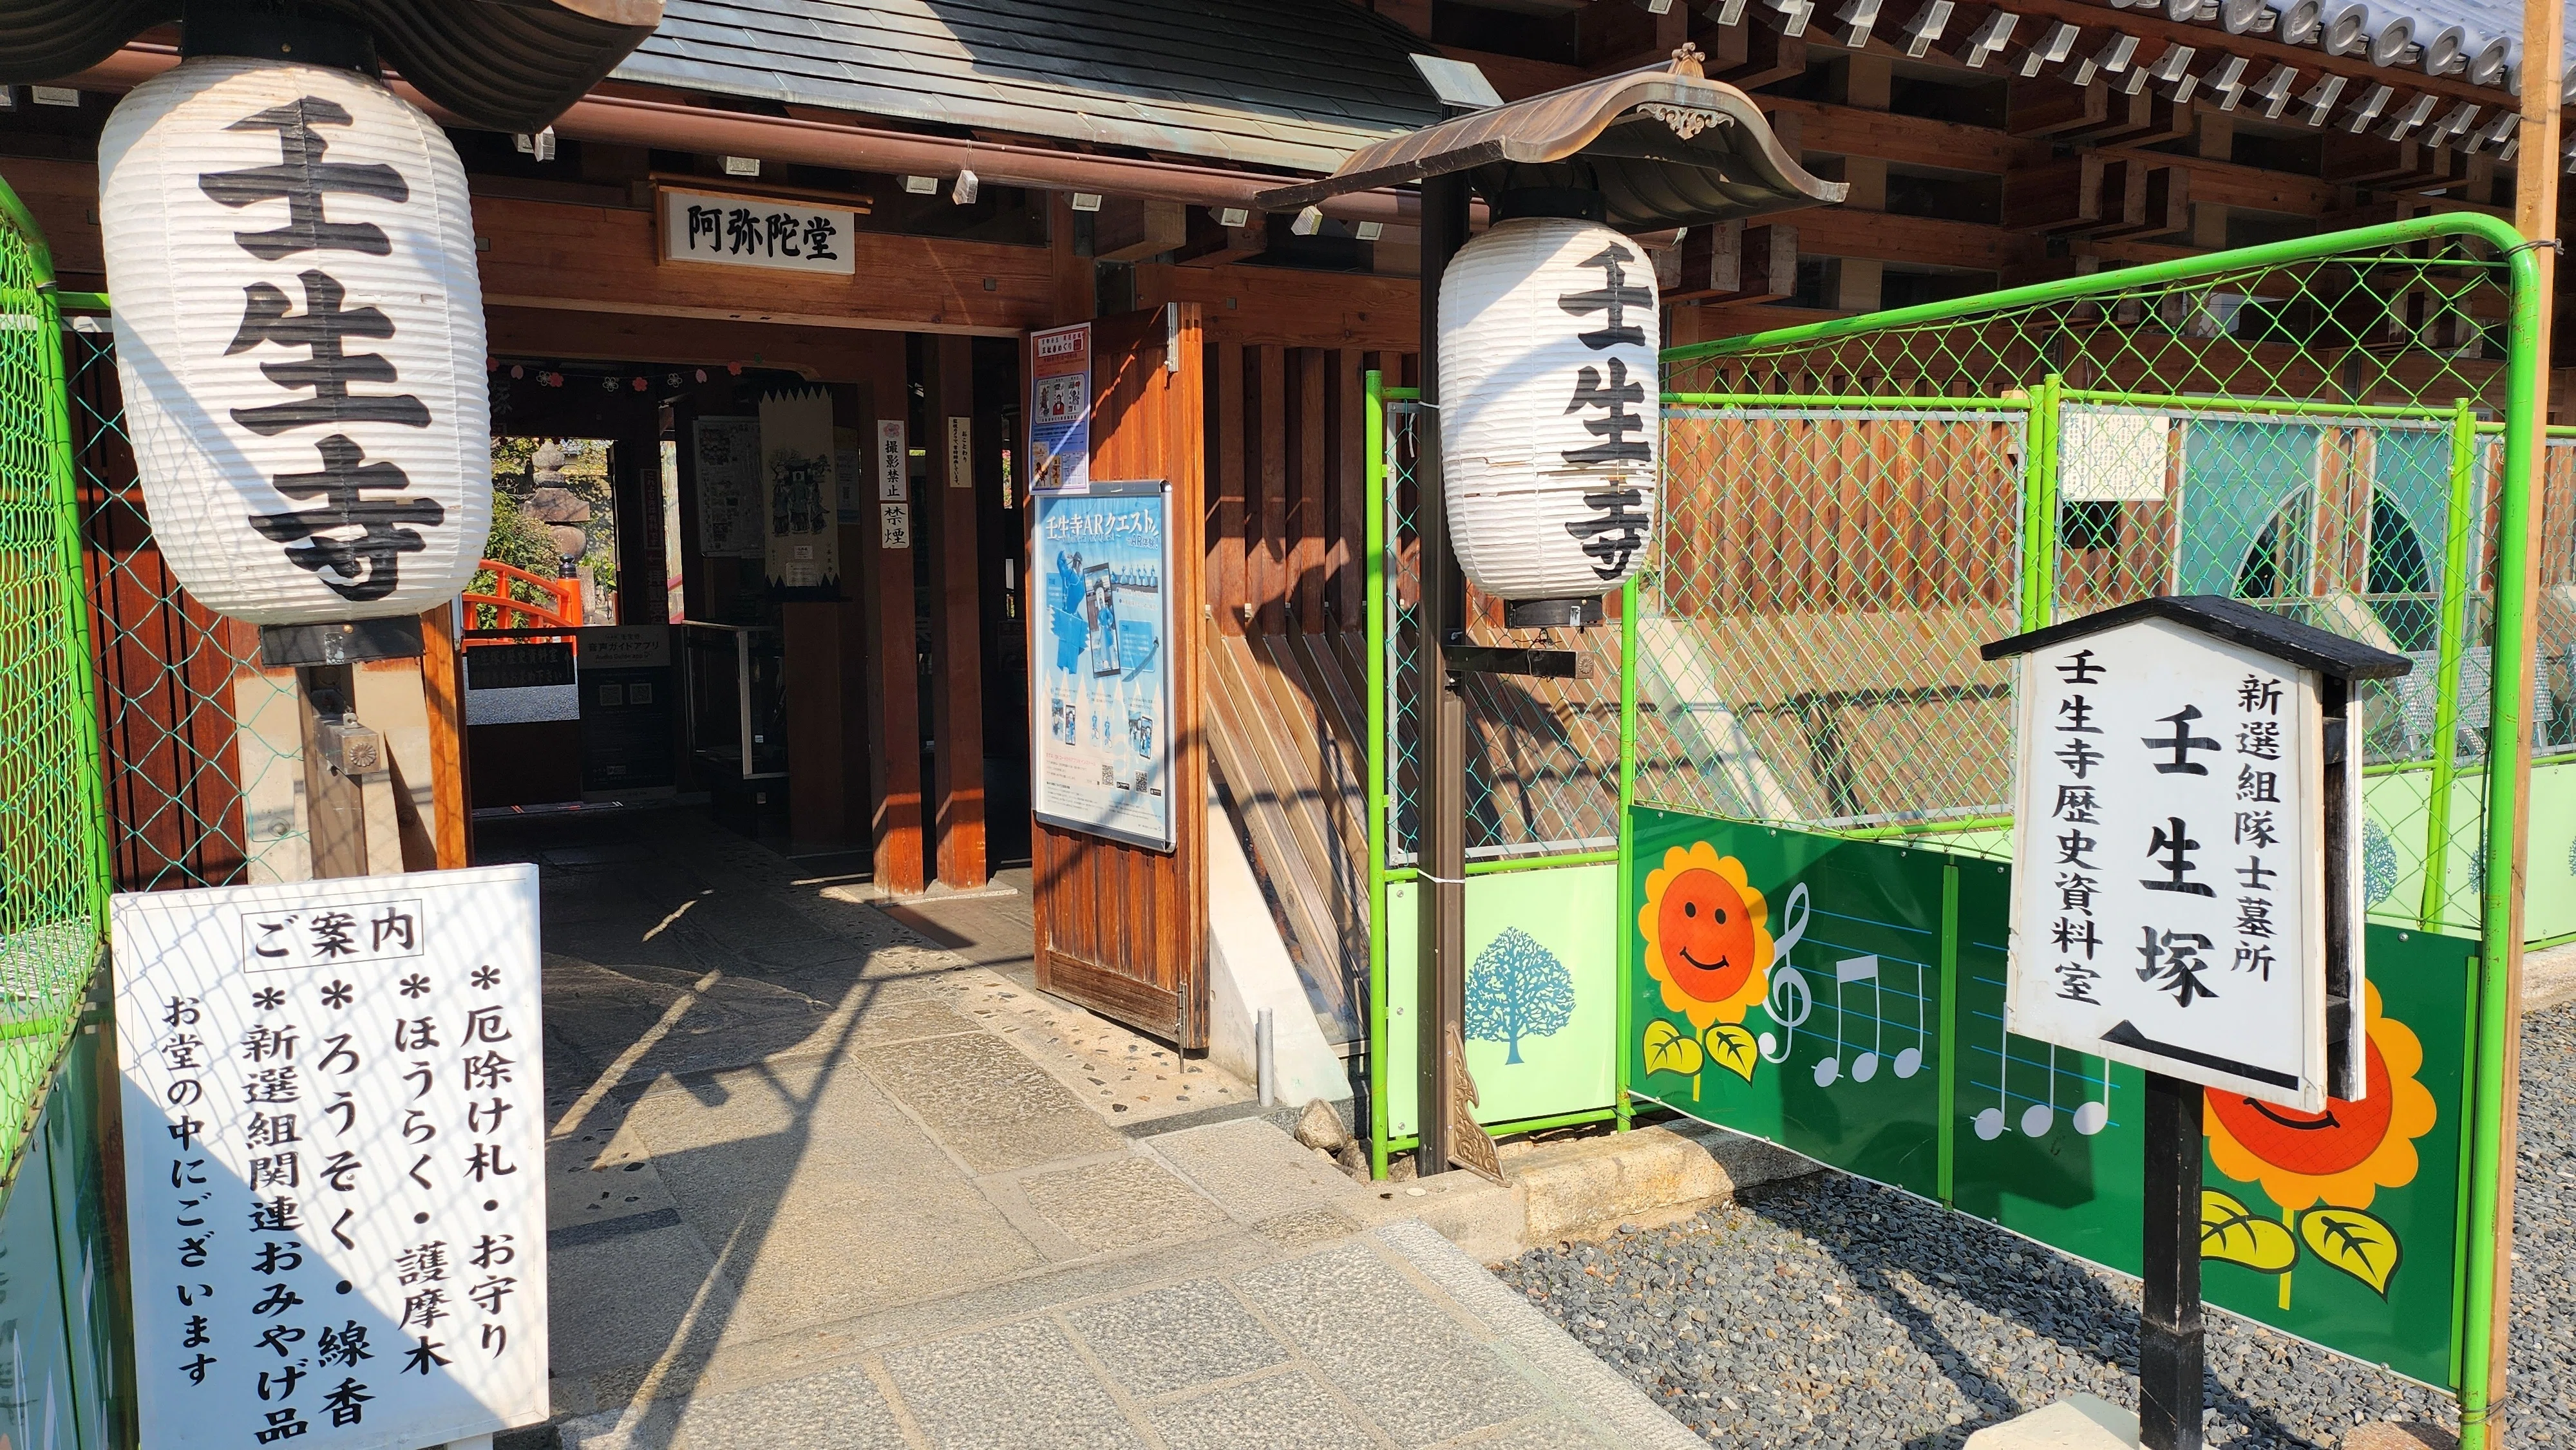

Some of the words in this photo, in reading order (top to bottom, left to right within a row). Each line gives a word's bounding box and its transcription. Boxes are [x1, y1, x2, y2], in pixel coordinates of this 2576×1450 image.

[198, 95, 445, 602] 壬生寺
[687, 205, 838, 261] 阿弥陀堂
[884, 506, 906, 545] 禁煙
[885, 440, 900, 497] 撮影禁止
[1046, 509, 1155, 539] 壬生寺ARクエスト
[1557, 241, 1654, 580] 壬生寺
[256, 906, 414, 958] ご案内
[2050, 649, 2107, 1006] 壬生寺歴史資料室
[2136, 704, 2222, 1008] 壬生塚
[2230, 673, 2284, 982] 新選組隊士墓所
[162, 996, 217, 1388] お堂の中にございます
